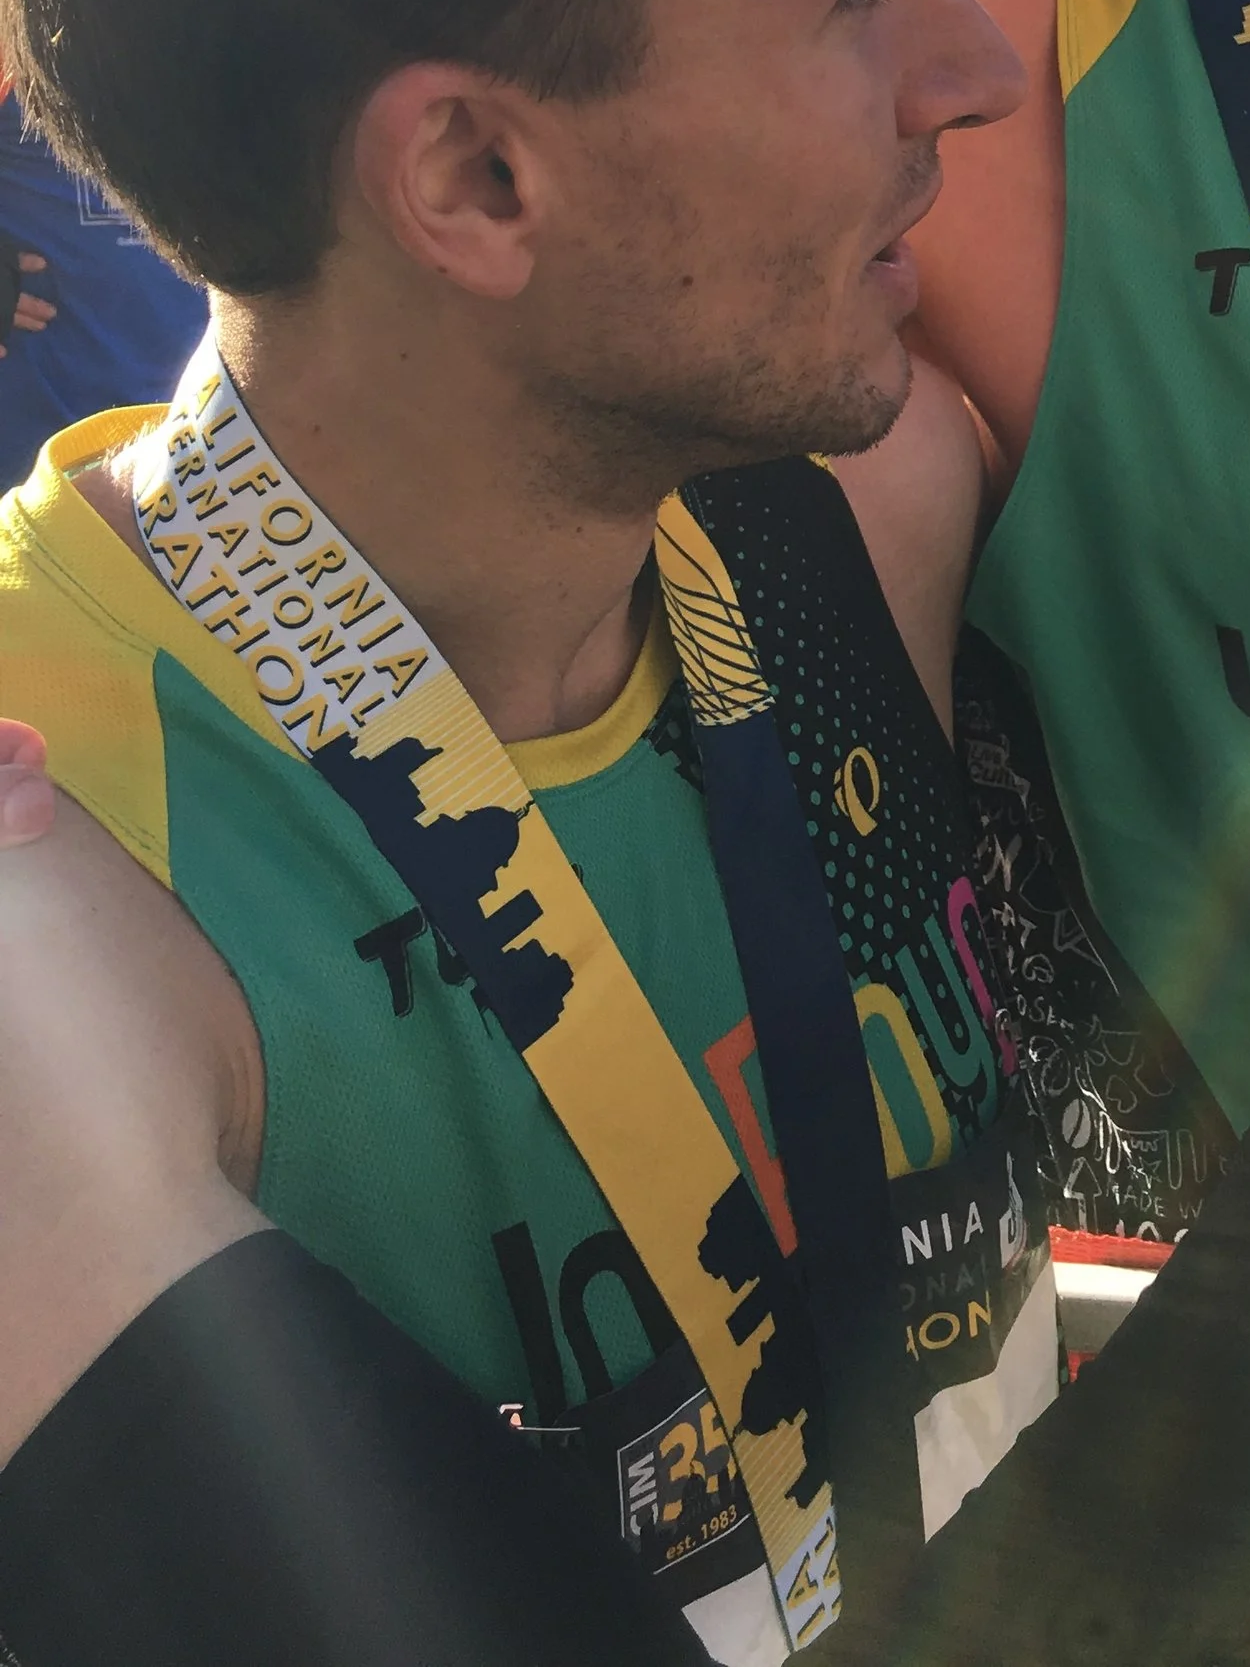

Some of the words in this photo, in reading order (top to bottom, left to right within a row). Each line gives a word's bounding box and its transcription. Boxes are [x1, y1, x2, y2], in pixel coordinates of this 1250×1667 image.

[137, 481, 351, 756] RATHON
[195, 373, 429, 699] ALIFORNIA
[665, 1535, 697, 1561] est.
[700, 1503, 738, 1541] 1983
